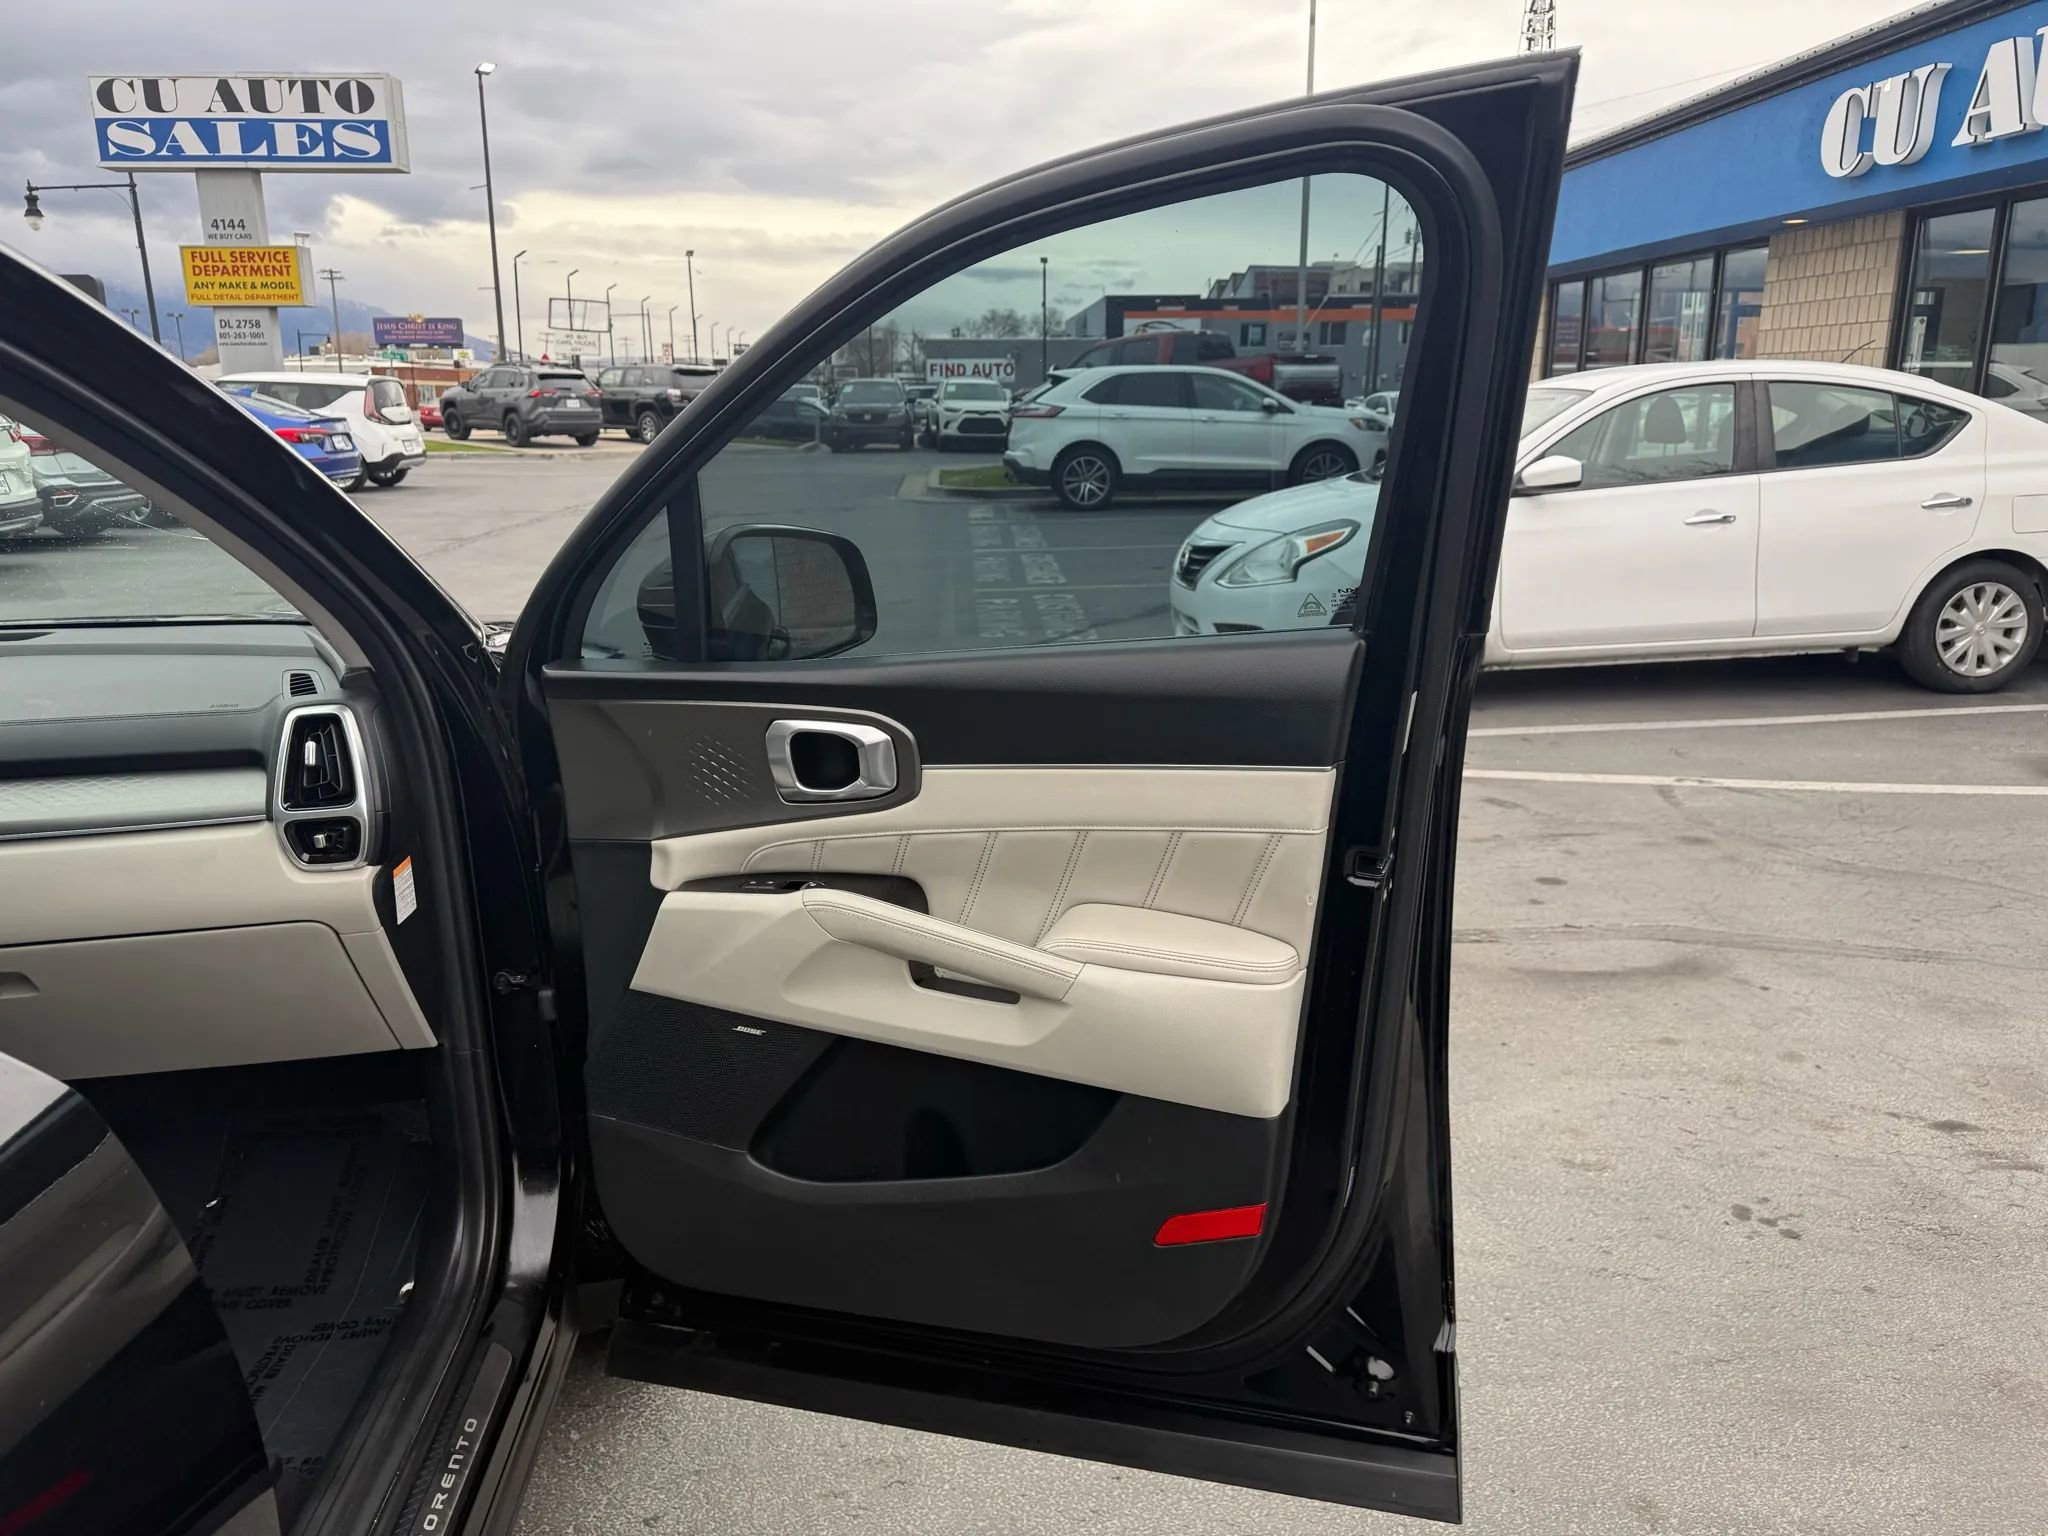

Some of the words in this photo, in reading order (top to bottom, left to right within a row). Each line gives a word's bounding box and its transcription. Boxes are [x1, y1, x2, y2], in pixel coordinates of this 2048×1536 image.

[96, 78, 180, 113] CU
[204, 79, 375, 114] AUTO
[1821, 63, 1952, 177] CU
[106, 120, 381, 158] SALES
[211, 218, 246, 231] 4144
[190, 250, 226, 263] FULL
[229, 250, 290, 263] SERVICE
[192, 264, 292, 277] DEPARTMENT
[193, 281, 215, 290] ANY
[218, 281, 249, 290] MAKE
[250, 281, 258, 290] &
[260, 281, 295, 290] MODEL
[190, 293, 211, 301] FULL
[213, 293, 242, 301] DETAIL
[244, 293, 299, 301] DEPARTMENT
[219, 319, 234, 329] DL
[235, 319, 261, 329] 2758
[398, 321, 426, 330] CHRIST
[437, 322, 457, 330] KING
[930, 363, 967, 377] FIND
[971, 362, 1015, 377] AUTO
[732, 1025, 766, 1036] BOSE
[418, 1418, 478, 1536] ORENTO
